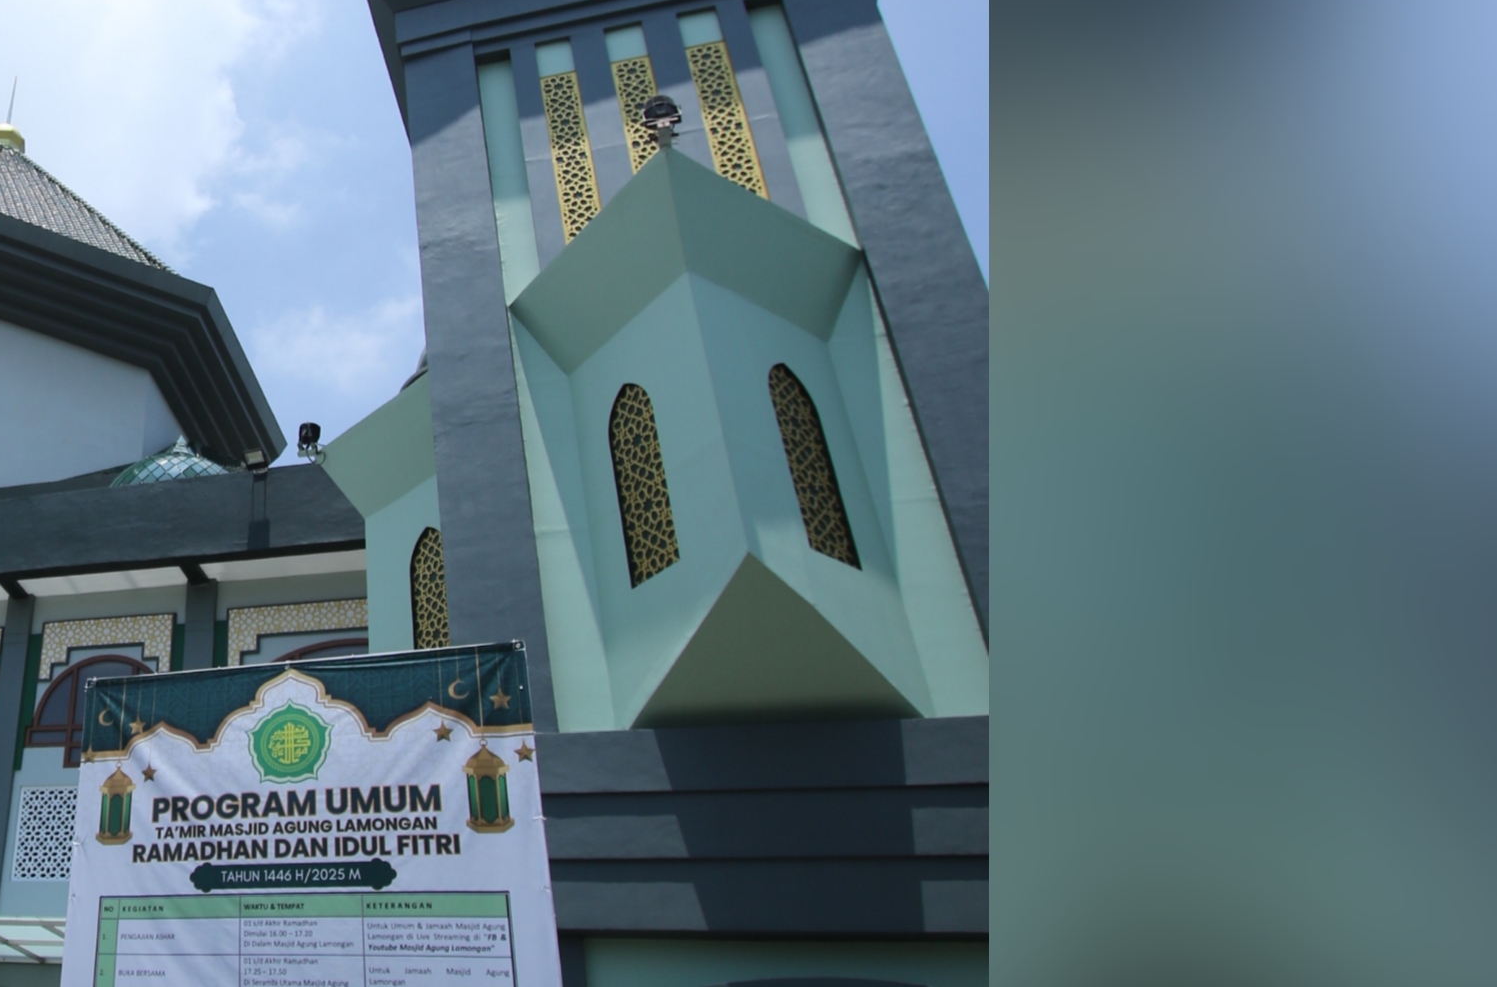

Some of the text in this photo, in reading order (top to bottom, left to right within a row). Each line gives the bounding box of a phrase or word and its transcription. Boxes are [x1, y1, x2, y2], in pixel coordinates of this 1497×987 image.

[152, 784, 442, 823] PROGRAM UMUM
[156, 817, 437, 839] TA'MIR MASJID AGUNG LAMONGAN
[132, 833, 461, 863] RAMADHAN DAN IDUL FITRI
[221, 868, 361, 883] TAHUN 1446 H/2025 M
[455, 923, 480, 931] Masjid
[482, 923, 506, 932] Agung
[367, 933, 404, 941] Lamongan
[433, 933, 471, 942] Streaming
[500, 933, 506, 941] &
[273, 941, 295, 949] Masjid
[296, 941, 318, 949] Agung
[319, 941, 354, 949] Lamongan
[399, 944, 424, 952] Masjid
[425, 944, 450, 953] Agung
[446, 967, 471, 977] Masjid
[486, 968, 510, 978] Agung
[251, 979, 278, 987] Serambi
[369, 979, 406, 987] Lamongan
